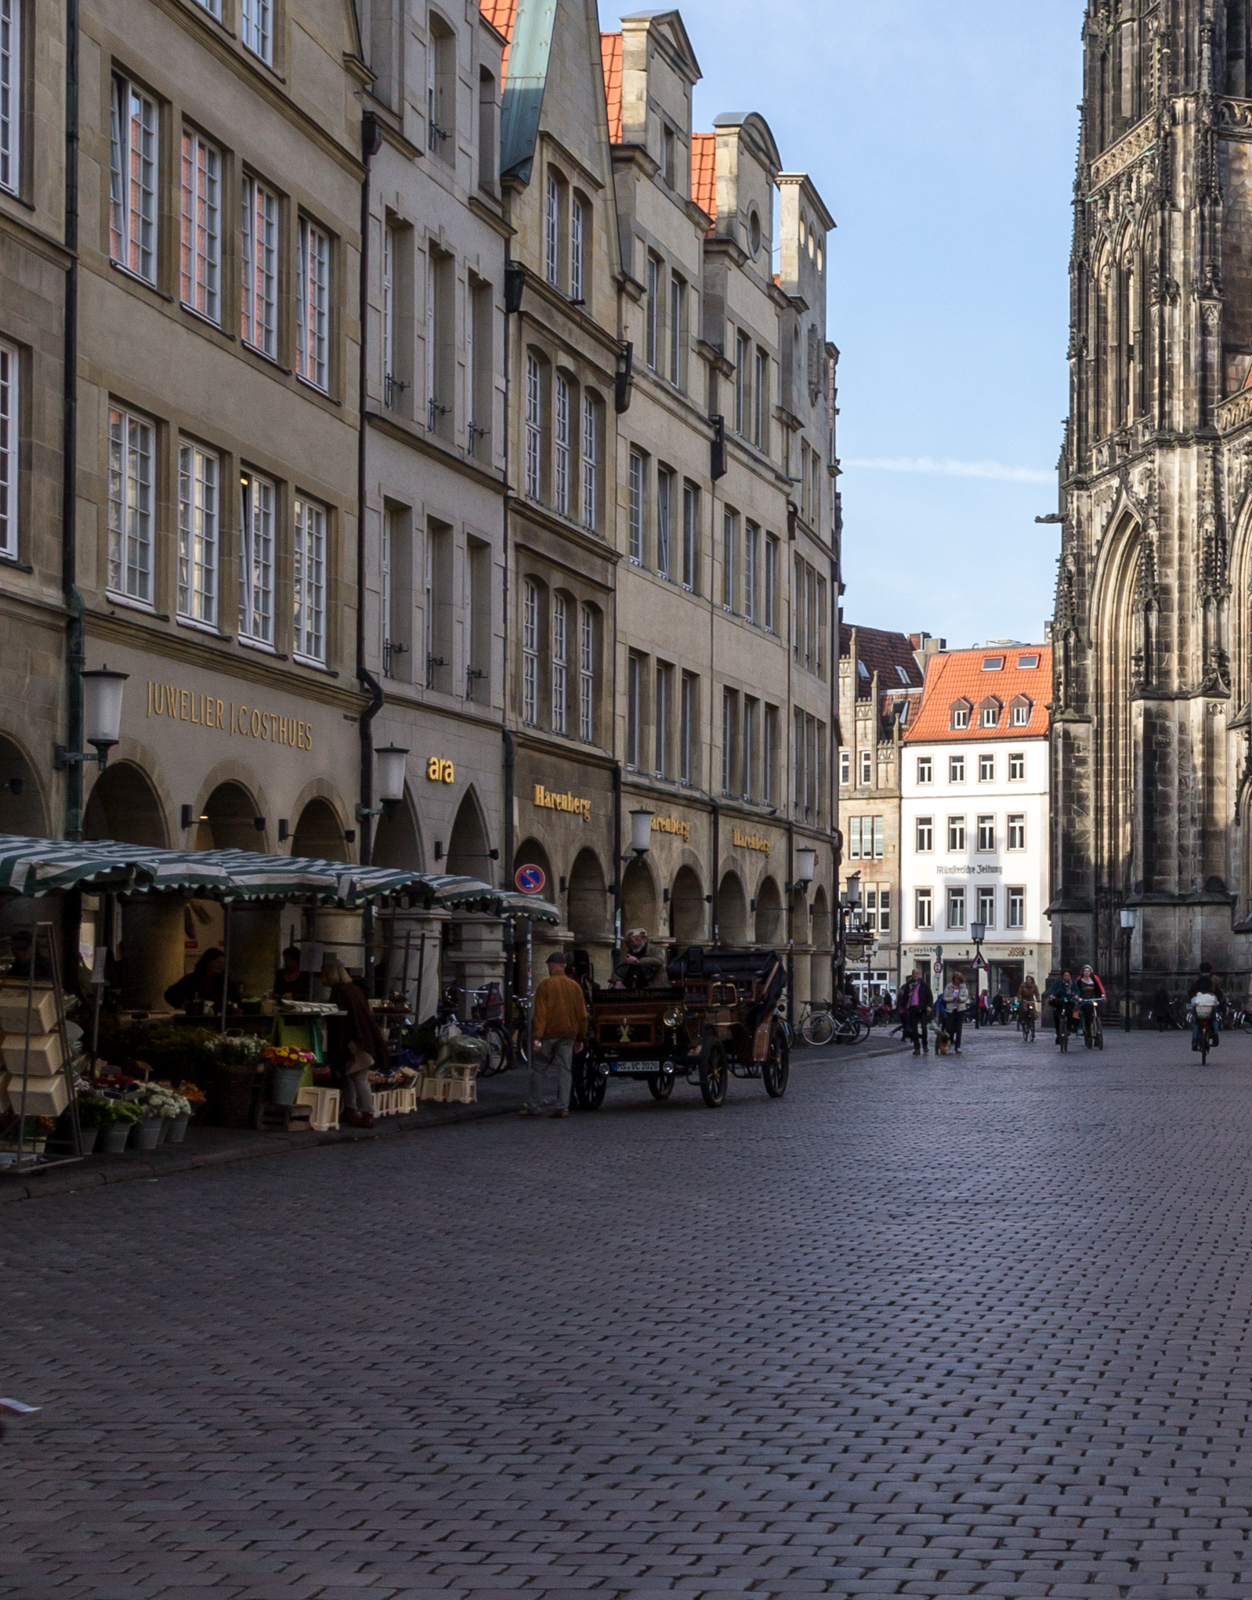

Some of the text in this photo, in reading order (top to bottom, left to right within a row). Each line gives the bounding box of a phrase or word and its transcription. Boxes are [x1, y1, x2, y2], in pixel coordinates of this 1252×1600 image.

[147, 681, 225, 730] JUWELIER
[428, 756, 454, 784] ara
[533, 784, 592, 822] Harenberg
[651, 815, 690, 842] arenberg
[732, 828, 772, 859] Harenberg
